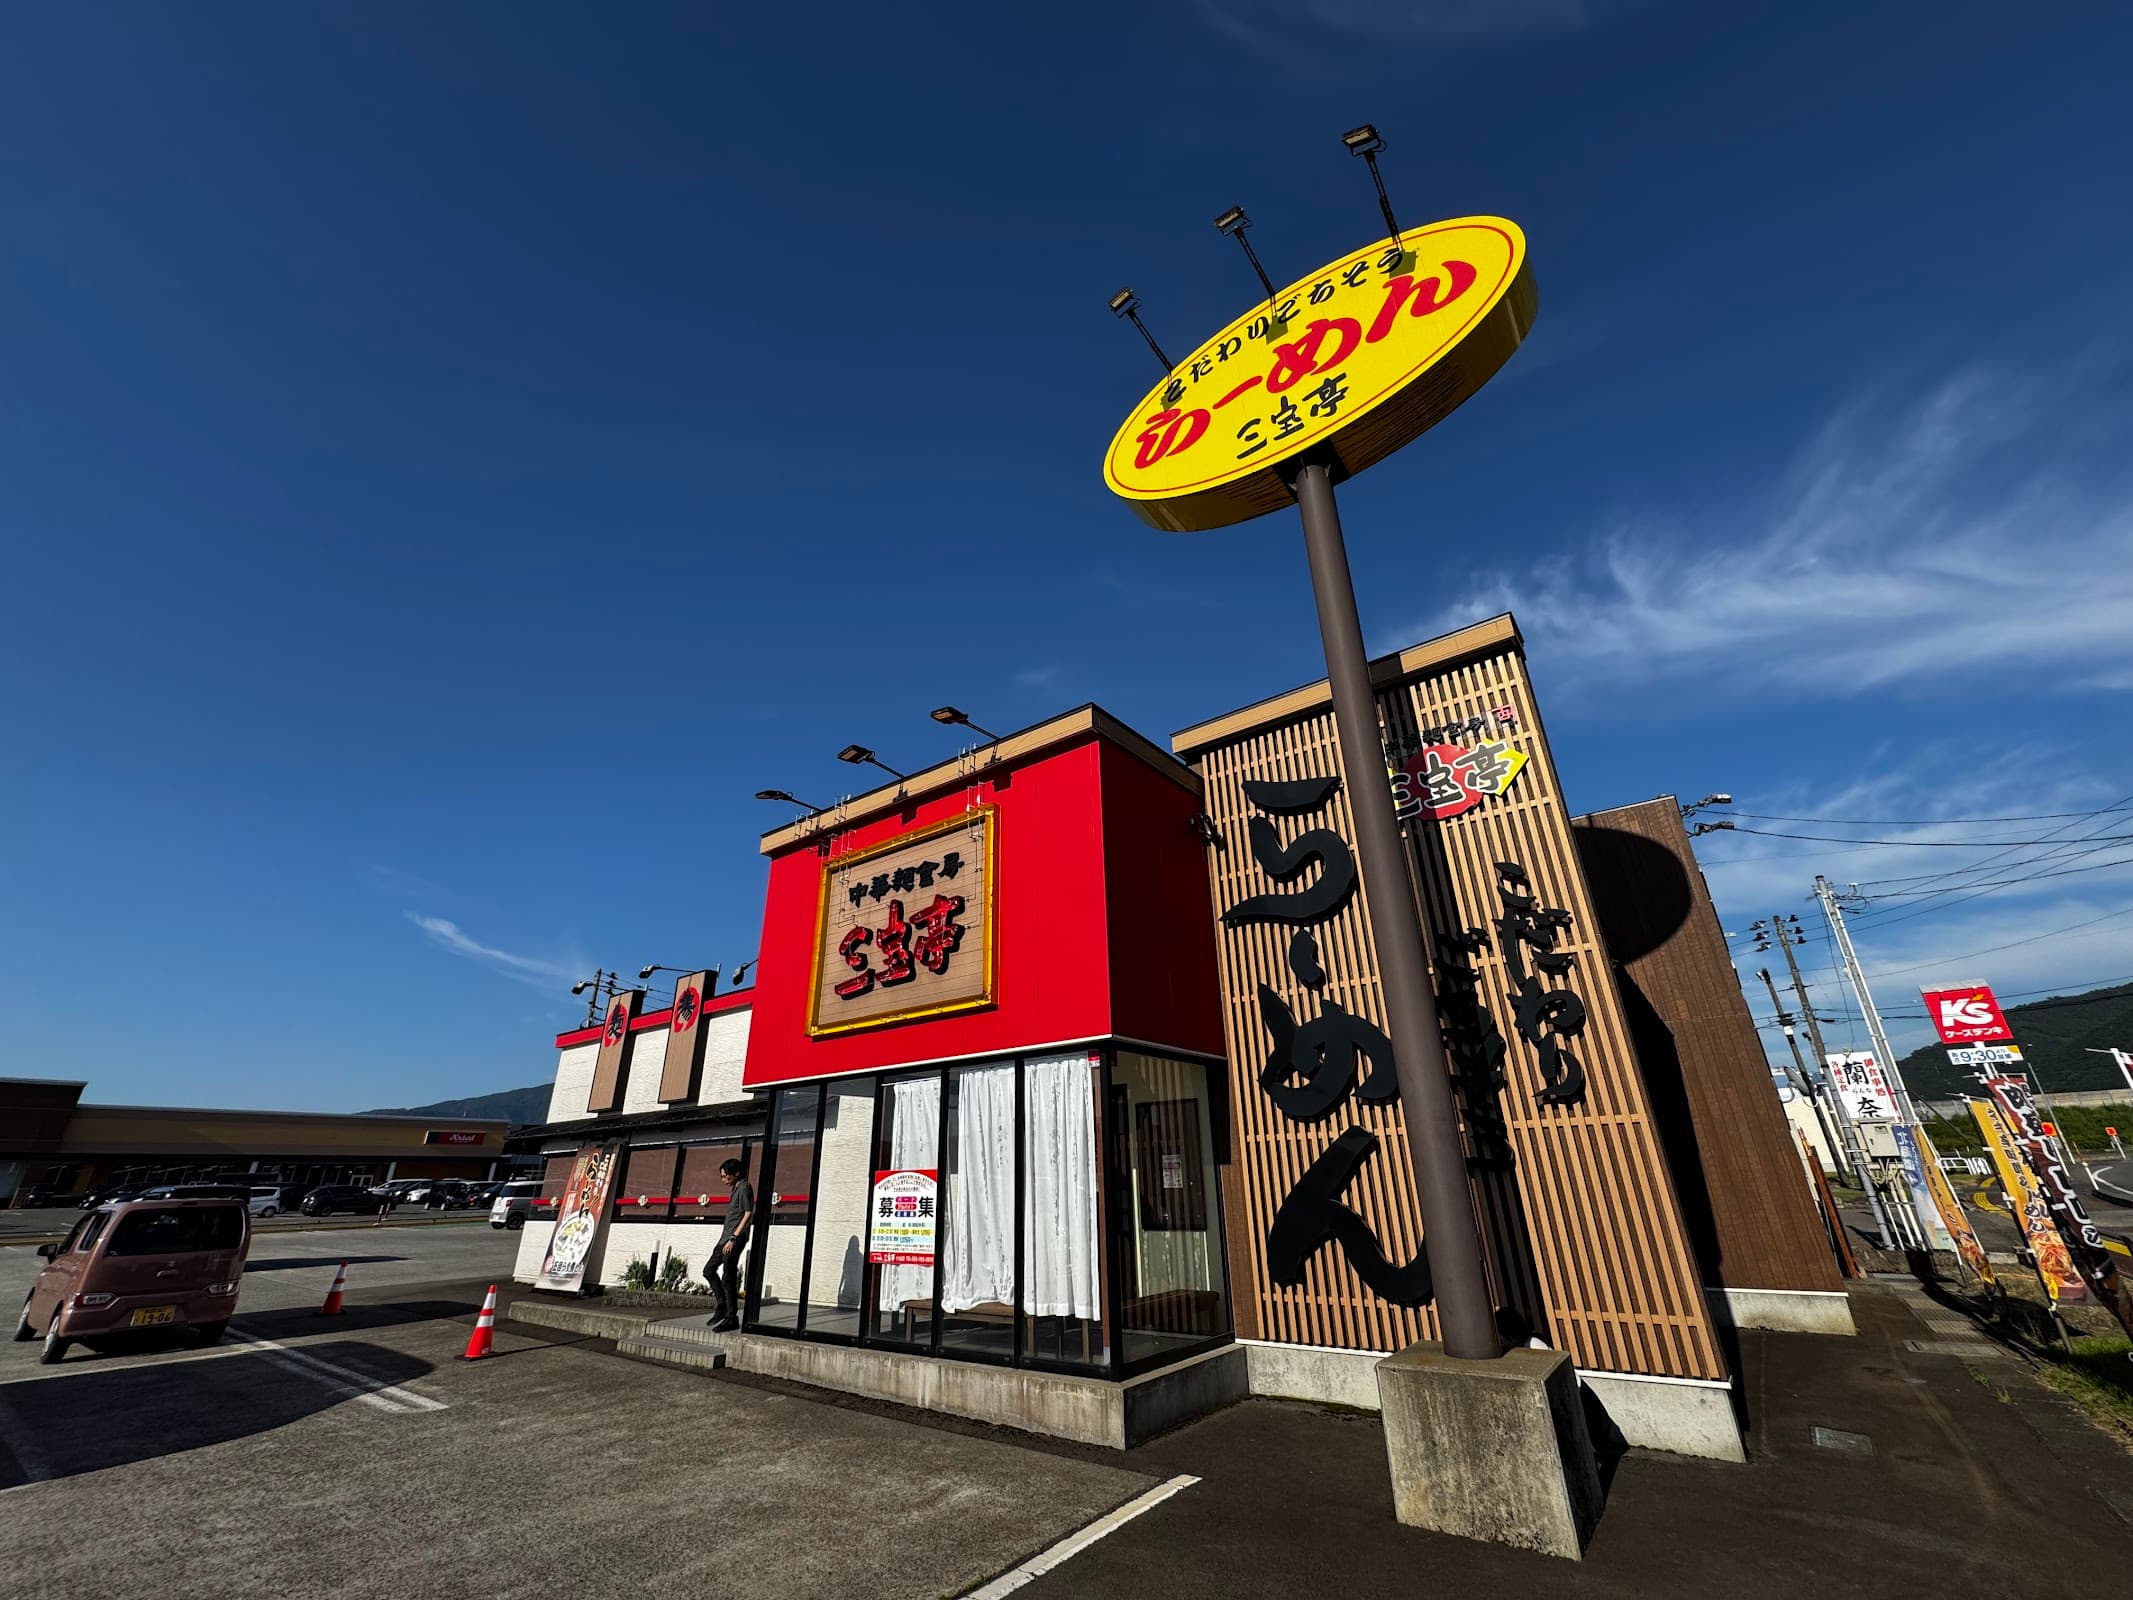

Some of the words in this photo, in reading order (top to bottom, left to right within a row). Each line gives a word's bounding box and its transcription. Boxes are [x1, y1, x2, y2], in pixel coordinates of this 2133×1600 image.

[1134, 260, 1477, 469] らーめん
[1236, 373, 1350, 460] 三宝亭
[834, 895, 966, 1000] 三宝亭
[1960, 1049, 1997, 1062] 9:30
